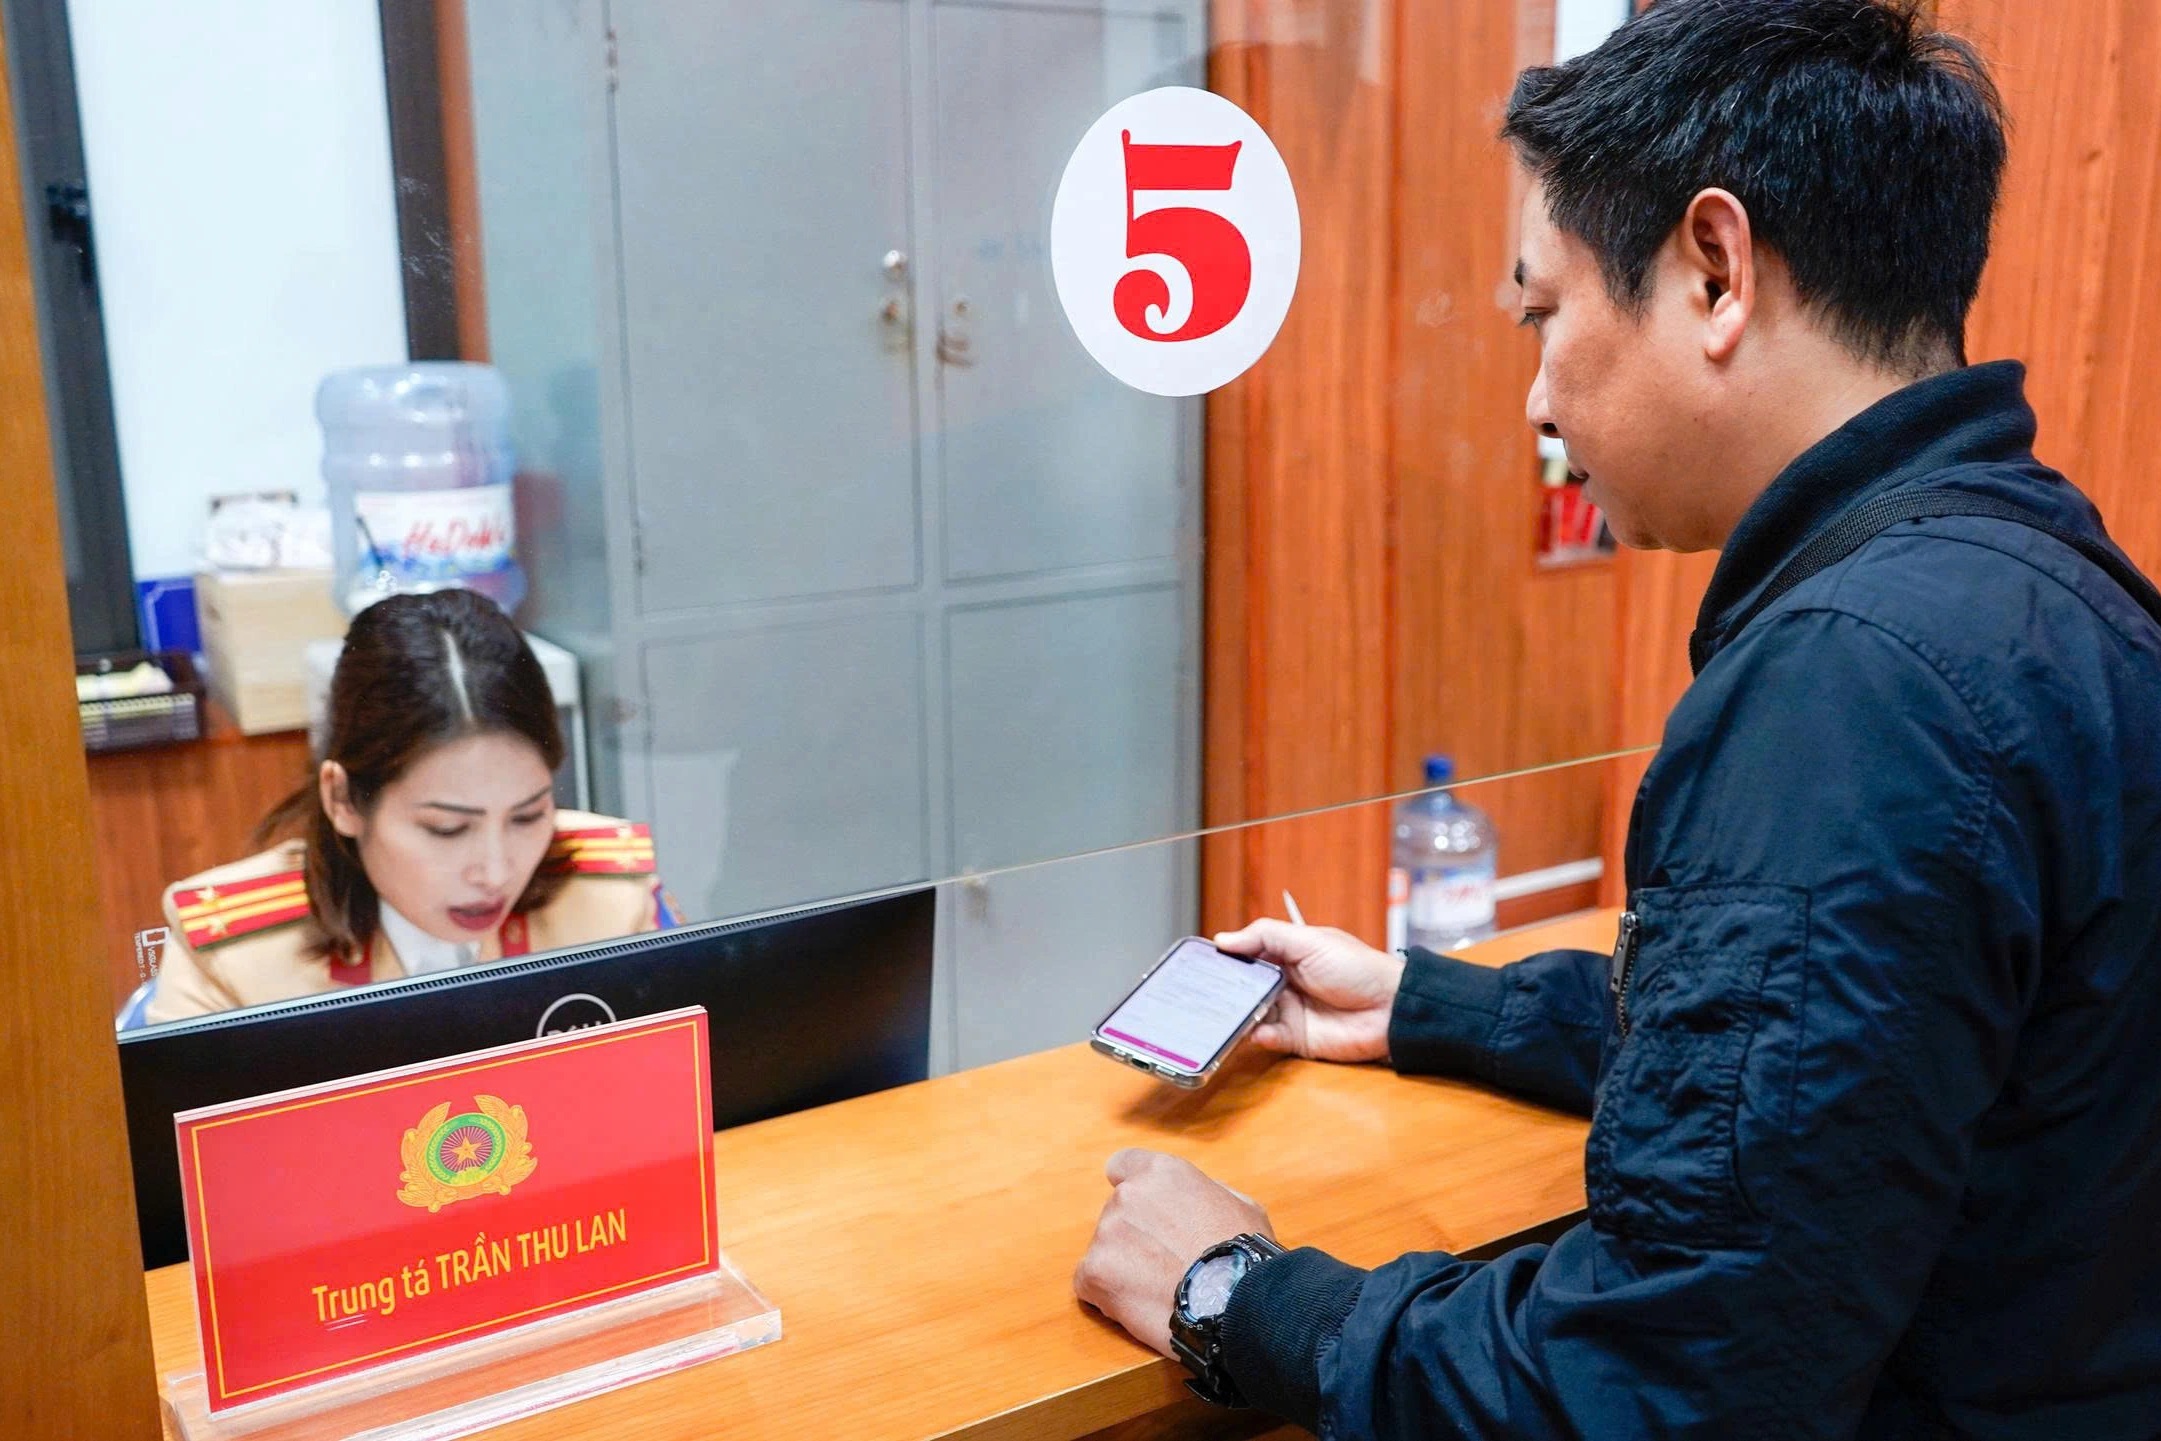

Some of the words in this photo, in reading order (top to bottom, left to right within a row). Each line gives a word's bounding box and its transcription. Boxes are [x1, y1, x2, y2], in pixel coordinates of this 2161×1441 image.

[1113, 129, 1251, 342] 5
[312, 1276, 396, 1321] Trung
[401, 1259, 431, 1299] tá
[436, 1232, 511, 1289] TRẦN
[516, 1223, 569, 1268] THU
[575, 1208, 627, 1253] LAN
